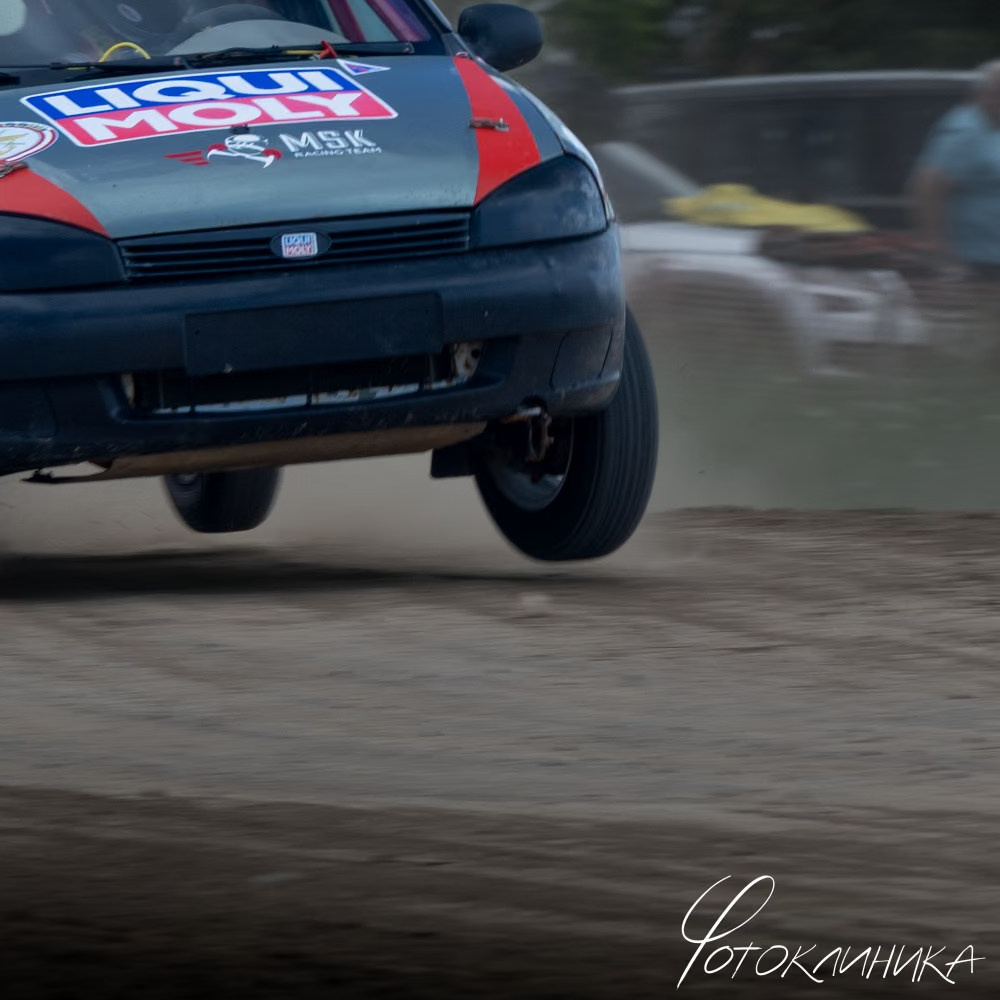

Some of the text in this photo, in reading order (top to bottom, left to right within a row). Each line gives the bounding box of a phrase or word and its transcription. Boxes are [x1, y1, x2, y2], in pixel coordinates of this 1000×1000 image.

[42, 70, 345, 117] LIQUI
[73, 92, 363, 142] MOLY
[279, 129, 377, 153] MSK
[294, 146, 383, 159] RACING TEAM
[284, 234, 313, 246] LIQUI
[285, 244, 314, 257] MOLY
